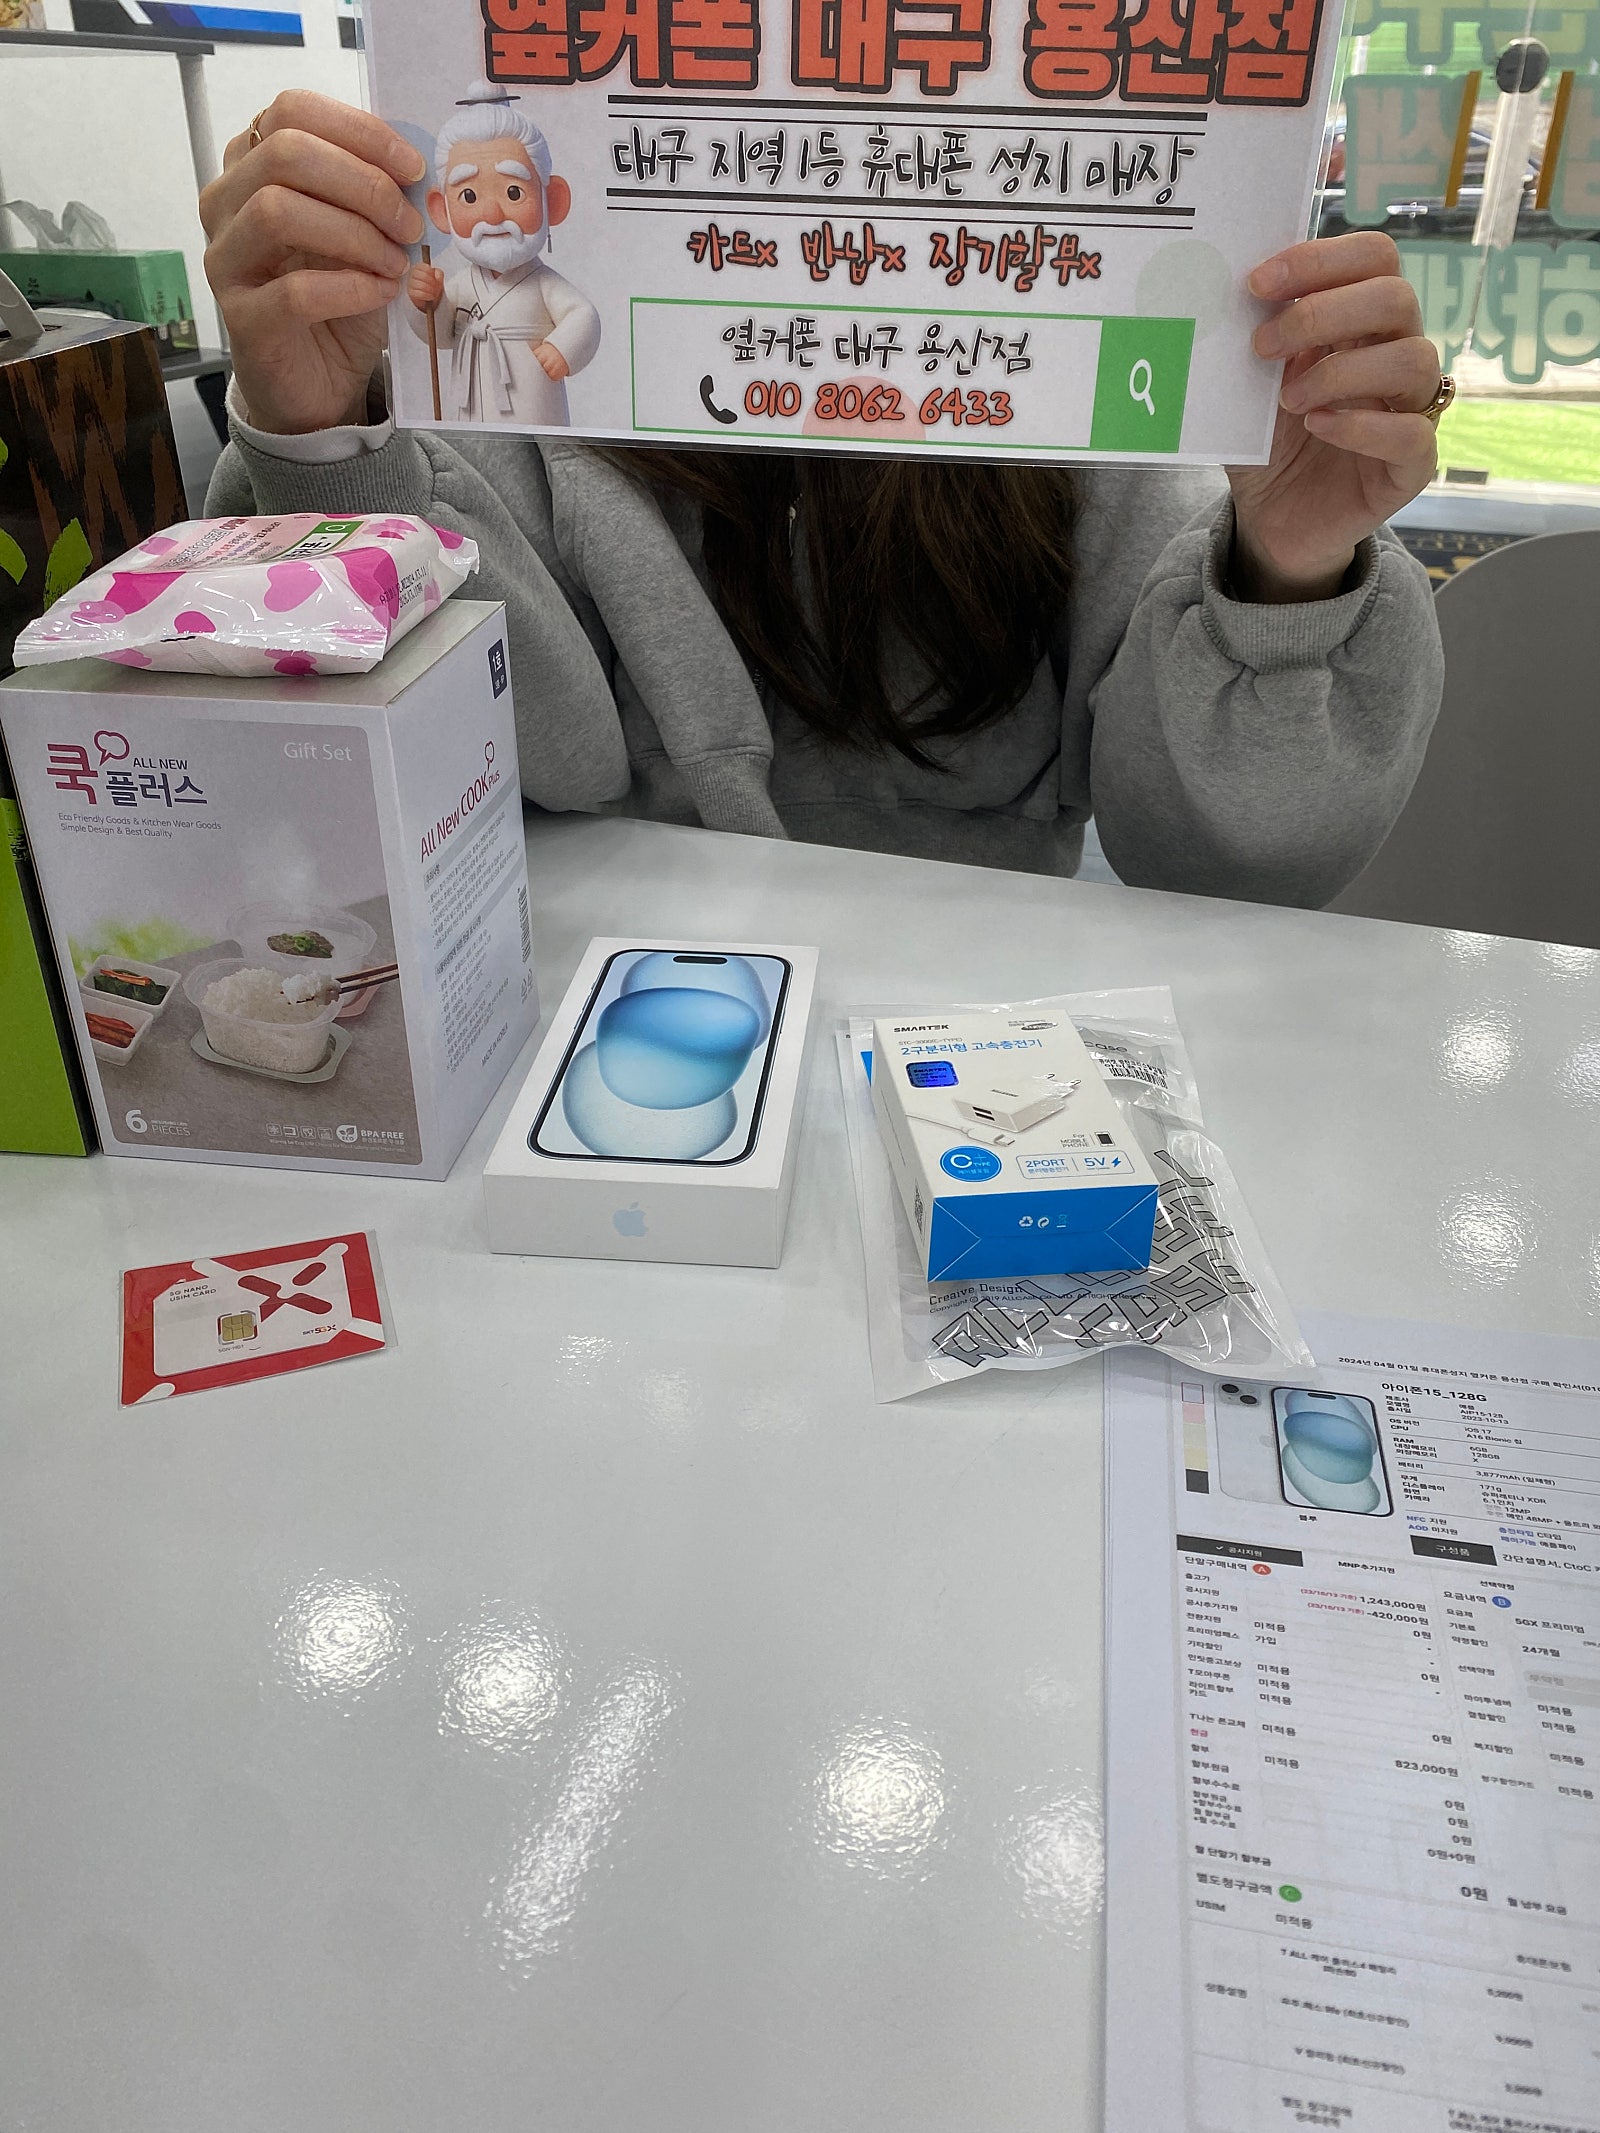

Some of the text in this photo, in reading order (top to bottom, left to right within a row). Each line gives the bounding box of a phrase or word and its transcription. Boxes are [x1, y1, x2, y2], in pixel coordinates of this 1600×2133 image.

[482, 0, 760, 90] 옆커폰
[791, 0, 991, 96] 대구
[1024, 0, 1324, 107] 용산점
[613, 124, 695, 185] 대구
[710, 128, 787, 187] 지역
[861, 124, 973, 198] 휴대폰
[988, 136, 1070, 195] 성지
[1085, 135, 1197, 206] 매장
[721, 315, 1034, 378] 옆커폰 대구 용산점
[744, 379, 1014, 426] 010 8062 6433
[284, 742, 353, 761] Gift Set
[133, 758, 188, 771] ALL NEW
[46, 743, 98, 805] 쿡
[105, 770, 208, 808] 플러스
[58, 812, 73, 821] Eco
[73, 813, 104, 825] Friendly
[105, 815, 131, 825] Goods
[142, 817, 171, 827] Kitchen
[173, 819, 194, 829] Wear
[195, 820, 222, 830] Goods
[420, 828, 437, 863] All
[436, 805, 460, 845] New
[460, 771, 489, 817] COOK
[61, 823, 87, 833] Simple
[88, 824, 115, 836] Design
[125, 827, 143, 836] Best
[144, 828, 172, 839] Quality
[893, 1024, 950, 1033] SMARTEK
[901, 1038, 1044, 1056] 2구분리형 고속충전기
[125, 1109, 149, 1133] 6
[151, 1124, 191, 1136] PIECES
[360, 1129, 405, 1140] BPA FREE
[1025, 1156, 1106, 1168] 2PORT 5V
[169, 1288, 217, 1302] USIM CARD
[183, 1284, 209, 1294] NANO
[979, 1283, 1024, 1295] Design
[1338, 1357, 1371, 1367] 2024년
[1381, 1382, 1487, 1402] 아이폰15_128G
[1475, 1470, 1521, 1481] 3,877mAh
[1479, 1484, 1502, 1493] 171g
[1504, 1506, 1531, 1515] 12MP
[1406, 1515, 1426, 1523] NFC
[1429, 1517, 1447, 1525] 지원
[1525, 1516, 1553, 1524] 48MP
[1408, 1524, 1429, 1532] AOD
[1431, 1526, 1459, 1536] 미지원
[1563, 1562, 1592, 1572] CtoC
[1359, 1596, 1427, 1612] 1,243,000원
[1366, 1611, 1429, 1626] -420,000원
[1254, 1621, 1287, 1633] 미적용
[1413, 1630, 1432, 1640] 0원
[1541, 1620, 1585, 1634] 프리미엄
[1255, 1635, 1277, 1645] 가입
[1521, 1645, 1561, 1658] 24개월
[1257, 1663, 1290, 1676] 미적용
[1258, 1678, 1291, 1690] 미적용
[1420, 1673, 1440, 1684] 0원
[1259, 1693, 1293, 1706] 미적용
[1262, 1723, 1297, 1737] 미적용
[1432, 1734, 1452, 1745] 0원
[1264, 1755, 1300, 1769] 미적용
[1394, 1759, 1459, 1777] 823,000원
[1444, 1799, 1466, 1811] 0원
[1447, 1817, 1469, 1829] 0원
[1451, 1834, 1473, 1847] 0원
[1460, 1886, 1489, 1902] 0원
